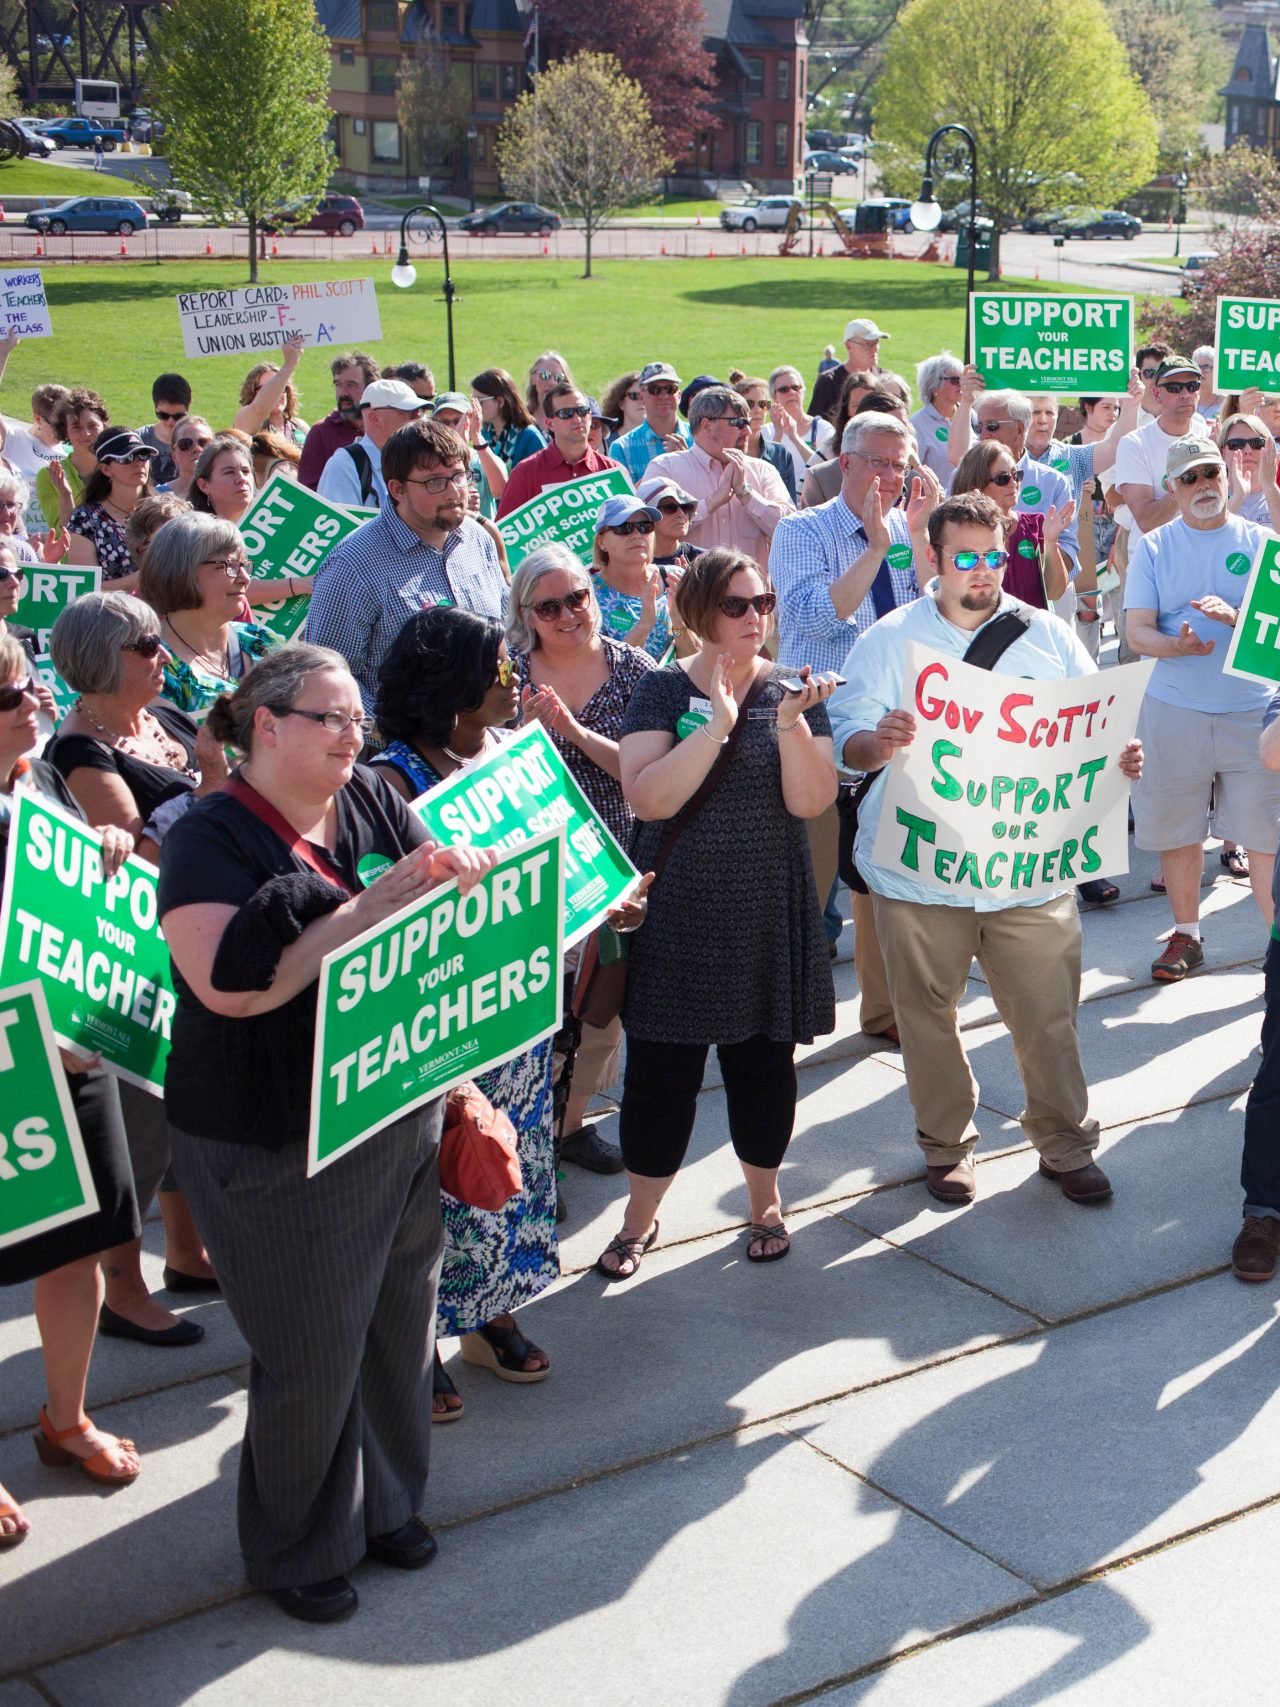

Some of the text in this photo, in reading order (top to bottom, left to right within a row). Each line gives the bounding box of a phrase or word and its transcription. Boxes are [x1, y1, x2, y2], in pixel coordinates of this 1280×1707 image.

[178, 279, 367, 313] REPORT CARD: PHIL SCOTT
[982, 300, 1122, 328] SUPPORT
[5, 312, 28, 323] THE
[197, 333, 246, 354] UNION
[316, 322, 337, 343] A+
[1036, 332, 1068, 342] YOUR
[980, 346, 1124, 372] TEACHERS
[500, 478, 615, 546] SUPPORT
[520, 525, 560, 556] YOUR
[559, 506, 601, 531] SCHO
[440, 742, 558, 846] SUPPORT
[992, 820, 1039, 840] OUR
[26, 812, 166, 942] SUPPO
[96, 915, 136, 956] YOUR
[336, 849, 550, 1013] SUPPORT
[16, 908, 178, 1041] TEACHER
[416, 953, 464, 996] YOUR
[329, 945, 551, 1106] TEACHERS
[418, 1038, 479, 1074] VERMONT-NEA
